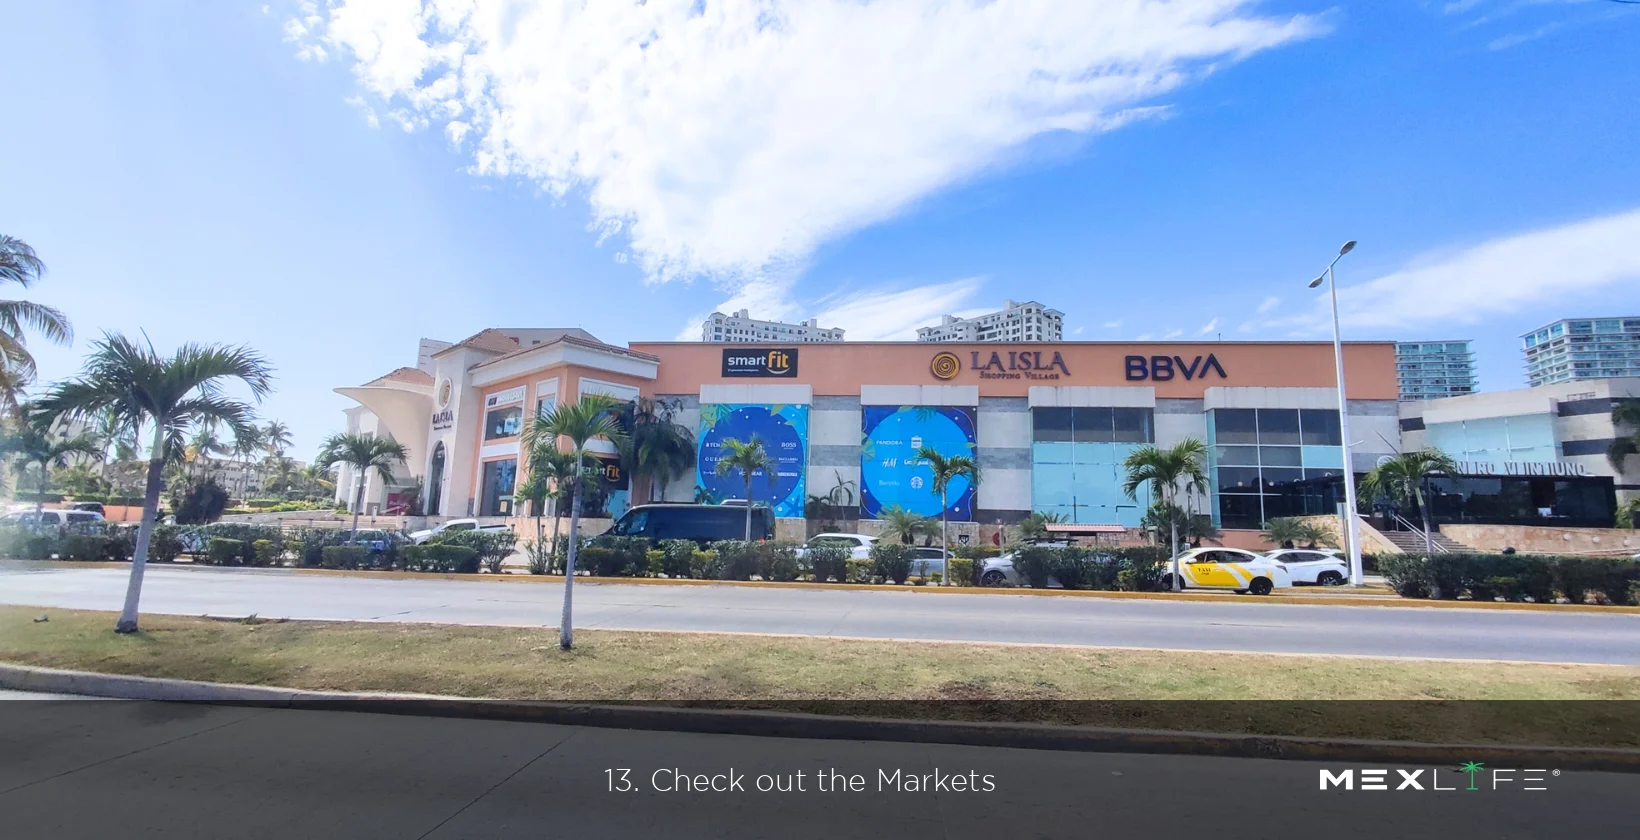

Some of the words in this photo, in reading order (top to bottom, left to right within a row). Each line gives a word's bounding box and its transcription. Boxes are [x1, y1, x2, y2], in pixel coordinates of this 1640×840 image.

[727, 355, 767, 367] smart
[767, 350, 789, 369] fit
[1124, 353, 1228, 381] BBVA
